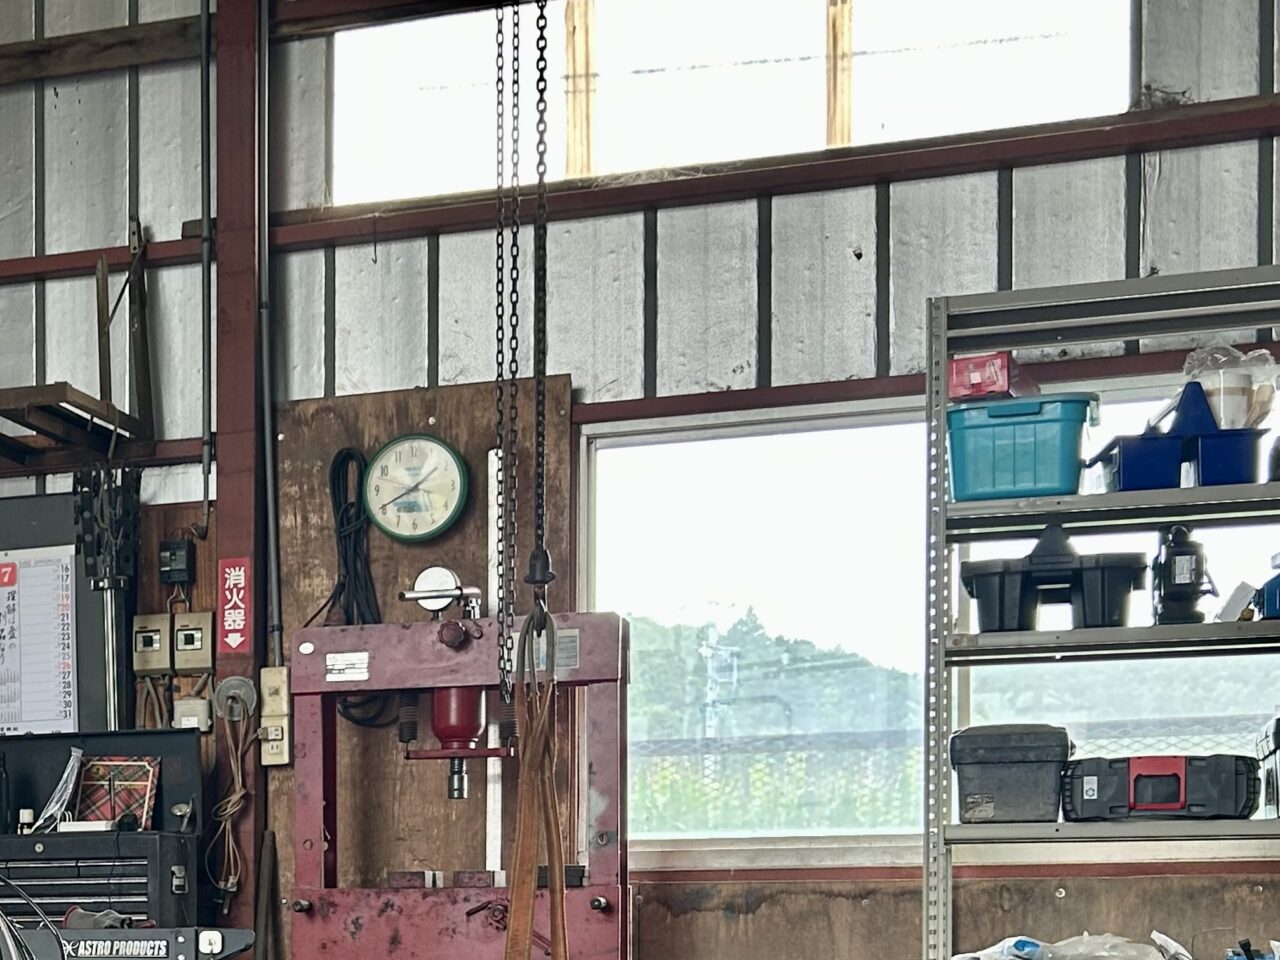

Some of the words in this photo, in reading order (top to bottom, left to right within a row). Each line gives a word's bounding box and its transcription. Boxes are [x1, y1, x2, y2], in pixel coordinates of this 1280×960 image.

[410, 446, 418, 457] 12
[395, 451, 402, 463] 11
[380, 465, 389, 477] 10
[450, 480, 455, 491] 3
[374, 484, 380, 496] 9
[381, 504, 387, 515] 8
[396, 515, 401, 527] 7
[412, 519, 418, 530] 6
[61, 565, 69, 573] 16
[1, 567, 12, 582] 7
[61, 574, 69, 583] 17
[61, 593, 69, 601] 19
[224, 567, 245, 630] 消火器
[60, 603, 70, 611] 20
[61, 613, 69, 621] 21
[61, 623, 70, 631] 22
[61, 632, 70, 640] 23
[61, 642, 70, 650] 24
[62, 652, 70, 660] 25
[62, 671, 71, 679] 27
[62, 681, 71, 689] 28
[63, 691, 72, 699] 29
[63, 710, 71, 718] 31
[77, 940, 112, 957] ASTRO
[112, 940, 168, 957] PRODUCTS
